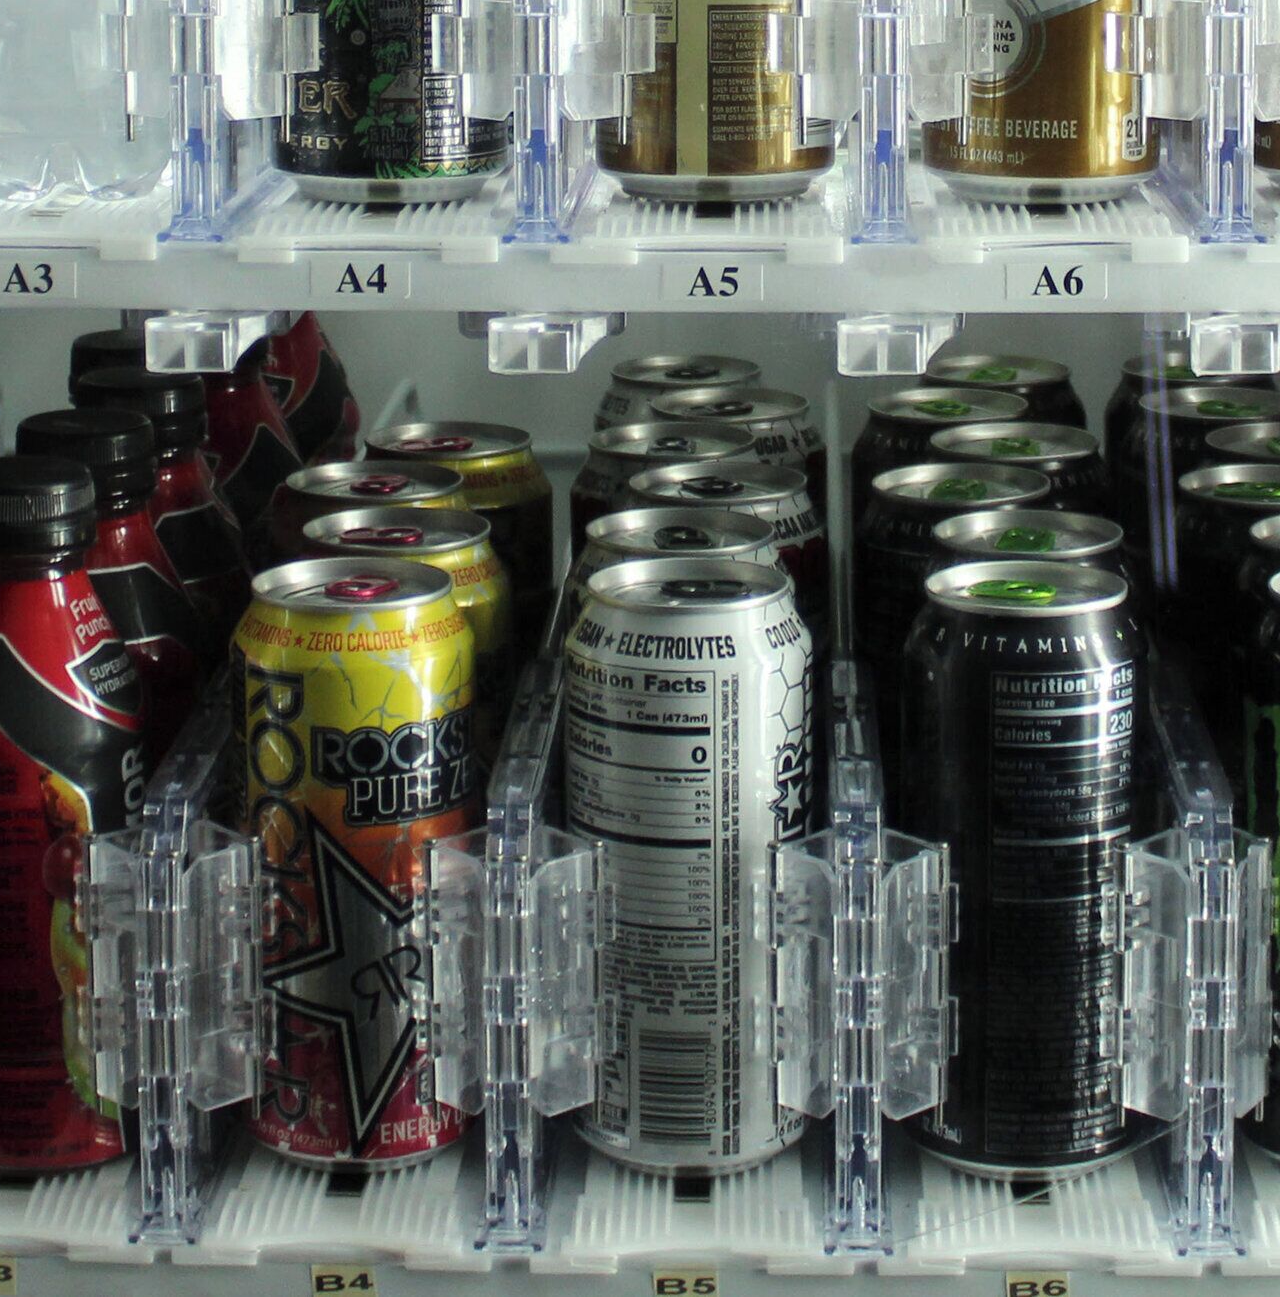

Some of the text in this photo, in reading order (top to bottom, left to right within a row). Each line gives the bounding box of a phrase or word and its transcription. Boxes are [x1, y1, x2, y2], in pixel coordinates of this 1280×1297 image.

[954, 116, 1078, 139] CFFEE BEVERAGE
[289, 134, 348, 150] ERGY
[3, 263, 53, 294] A3
[336, 263, 388, 294] A4
[687, 266, 740, 297] A5
[1032, 265, 1084, 296] A6
[306, 631, 343, 652] ZERO
[347, 629, 408, 652] CALORIE
[421, 622, 446, 643] ZERO
[616, 631, 736, 660] ELECTROLYTES
[963, 632, 1104, 654] VITAMINS
[643, 673, 707, 694] Facts
[995, 667, 1133, 694] Nutrition Fcts
[1036, 699, 1056, 708] size
[636, 711, 708, 724] Can (473ml)
[994, 709, 1133, 742] Calories 230
[315, 715, 473, 791] ROCKS
[691, 746, 707, 764] 0
[350, 768, 443, 818] PURE
[380, 1115, 452, 1145] ENERGY
[315, 1273, 373, 1293] B4
[656, 1277, 715, 1296] B5
[1009, 1280, 1066, 1297] B6
